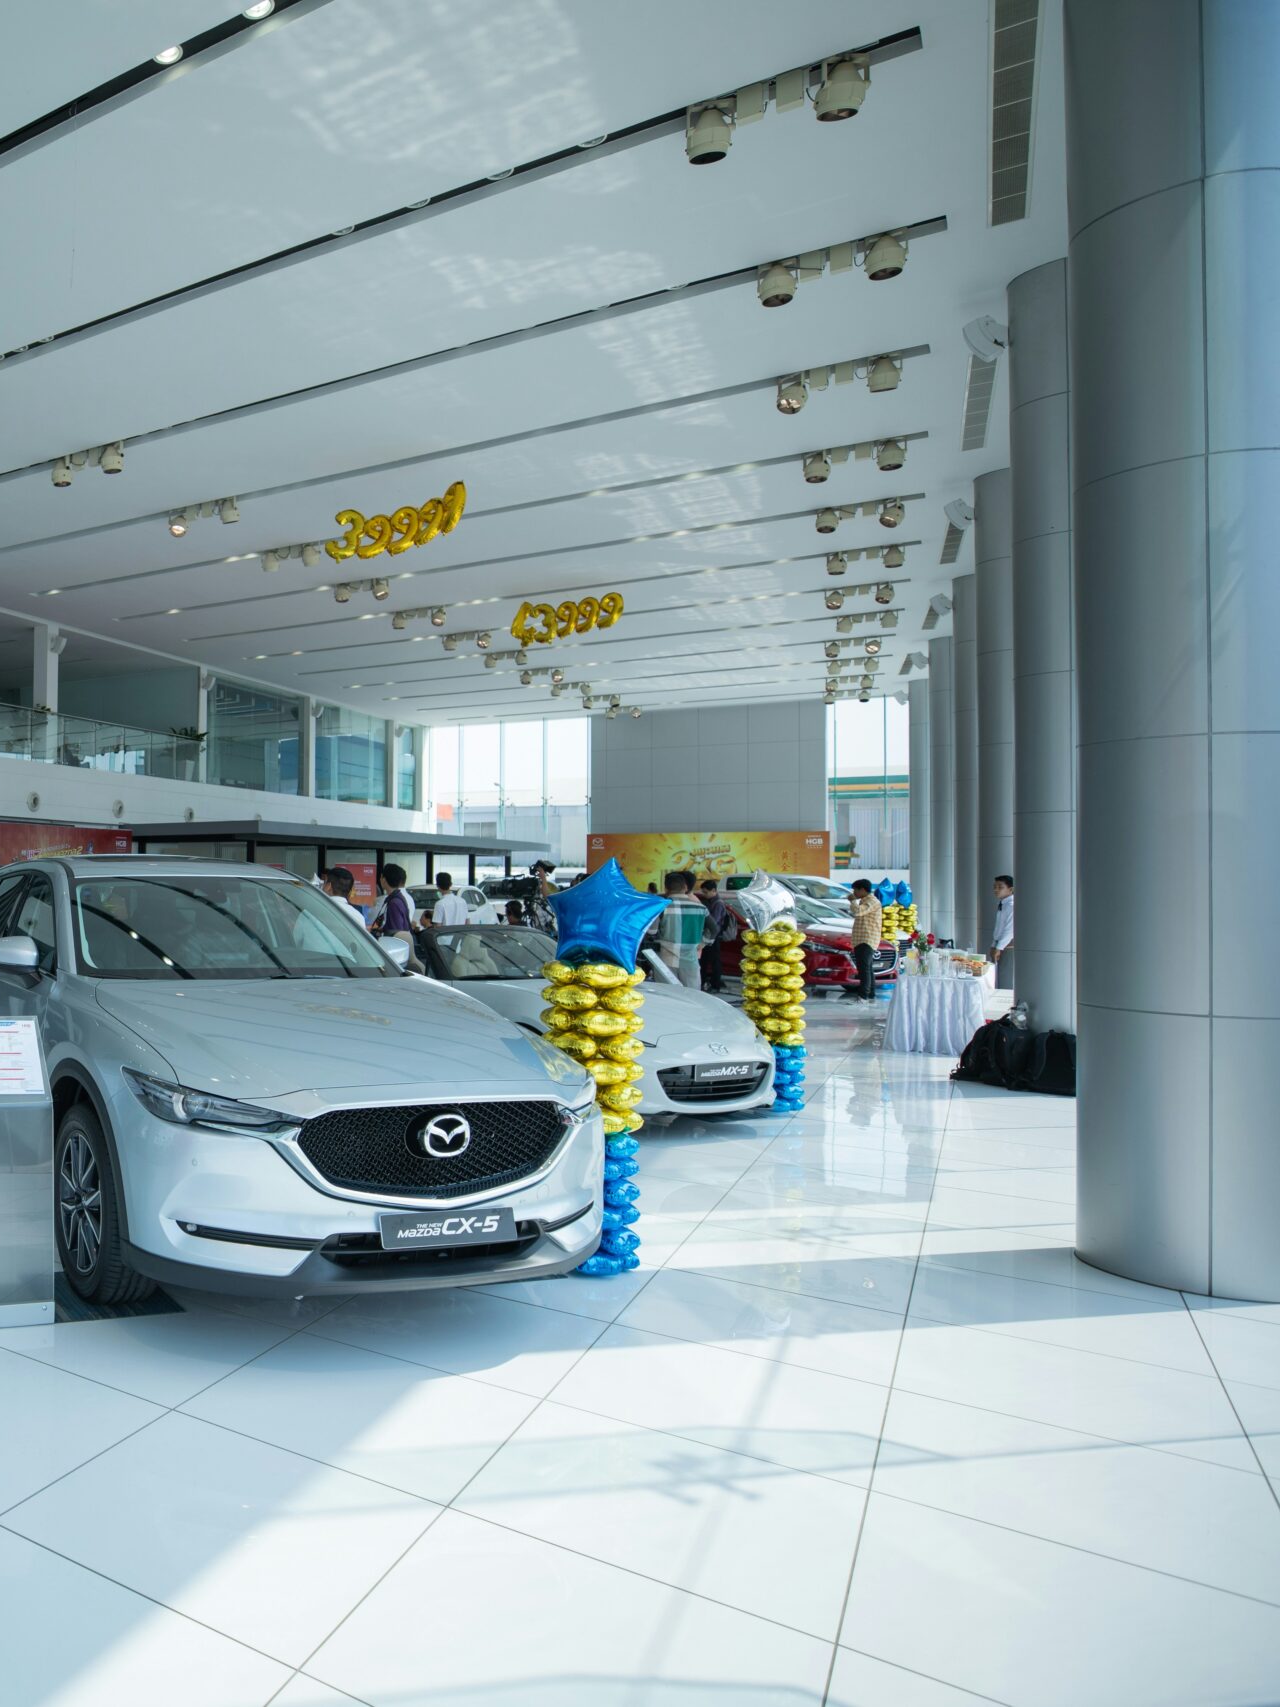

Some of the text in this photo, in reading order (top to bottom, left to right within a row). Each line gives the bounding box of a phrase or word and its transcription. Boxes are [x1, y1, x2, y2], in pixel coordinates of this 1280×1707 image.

[511, 592, 624, 647] 43999
[720, 1065, 749, 1076] MX-5
[441, 1215, 500, 1235] CX-5
